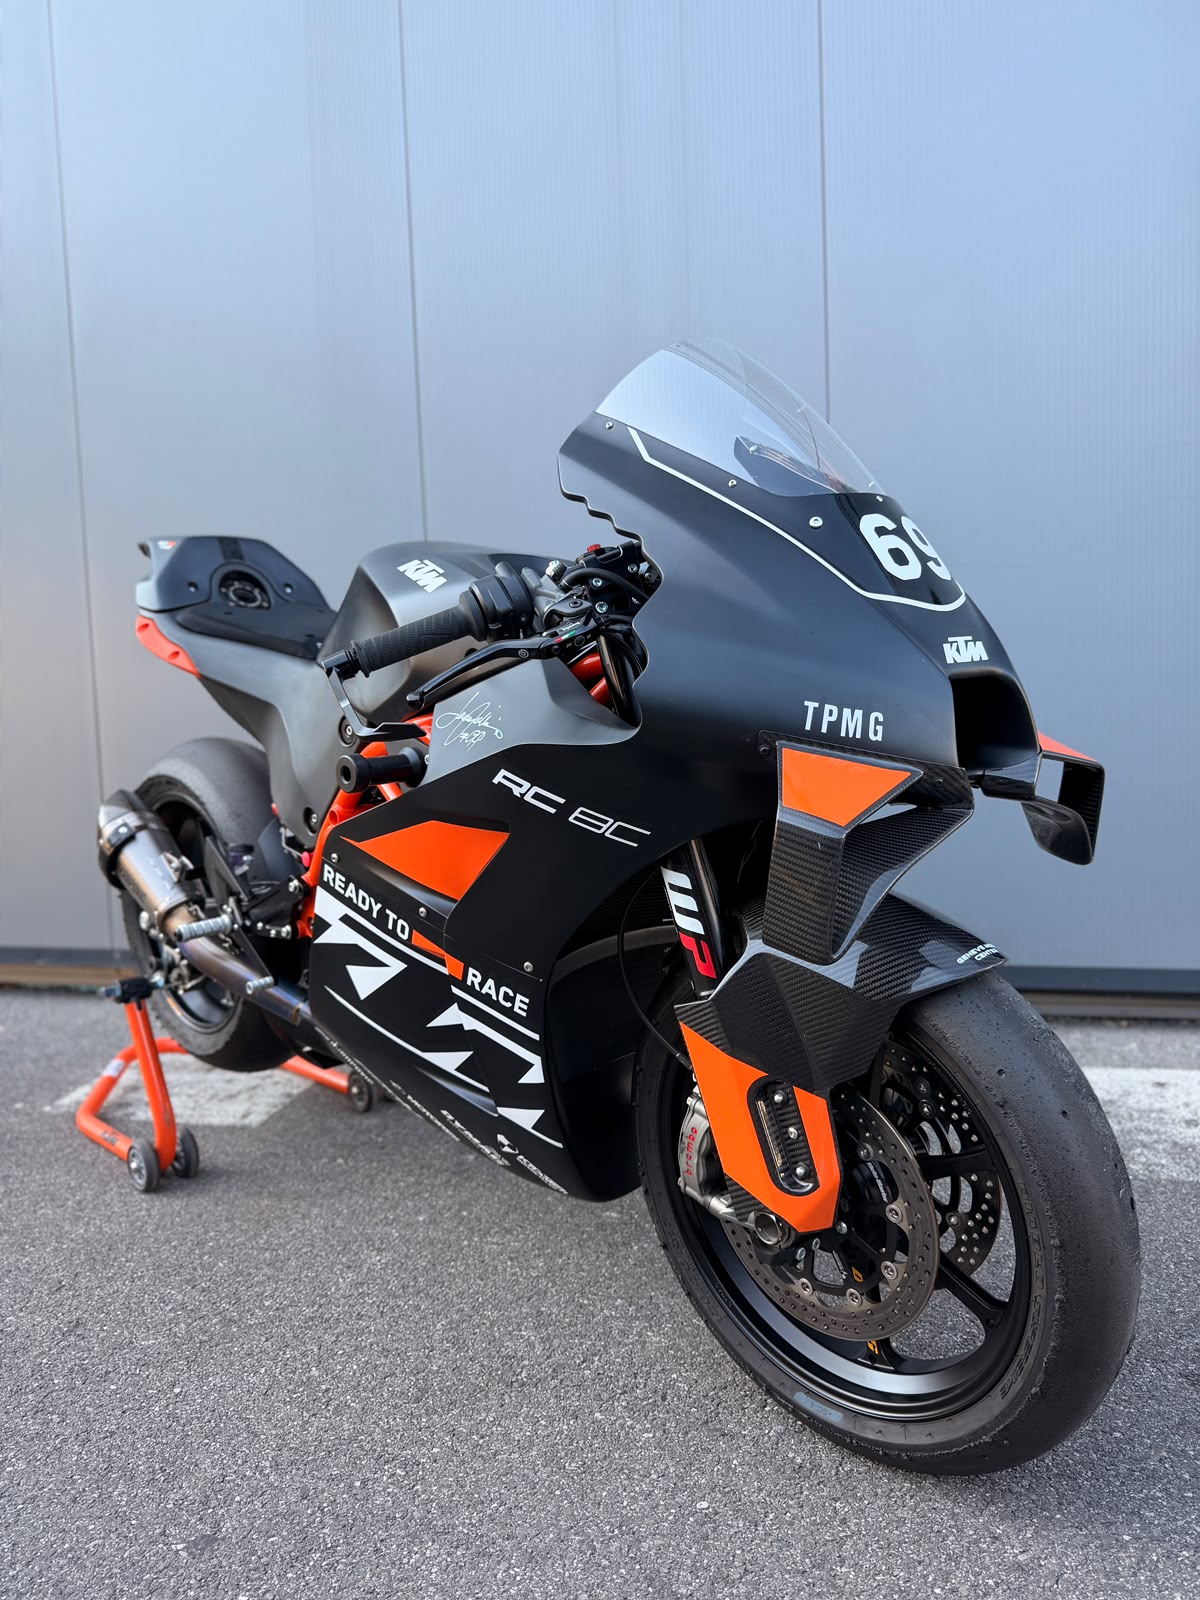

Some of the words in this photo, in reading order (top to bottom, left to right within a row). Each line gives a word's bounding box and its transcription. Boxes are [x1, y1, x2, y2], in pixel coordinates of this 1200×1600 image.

[859, 513, 951, 581] 69
[396, 559, 448, 594] KTM
[943, 635, 989, 664] KTM
[804, 700, 884, 742] TPMG
[492, 768, 567, 814] RC
[568, 806, 652, 847] 8C
[323, 863, 383, 920] READY
[385, 908, 410, 941] TO
[466, 967, 530, 1017] RACE
[683, 1126, 698, 1177] brembo
